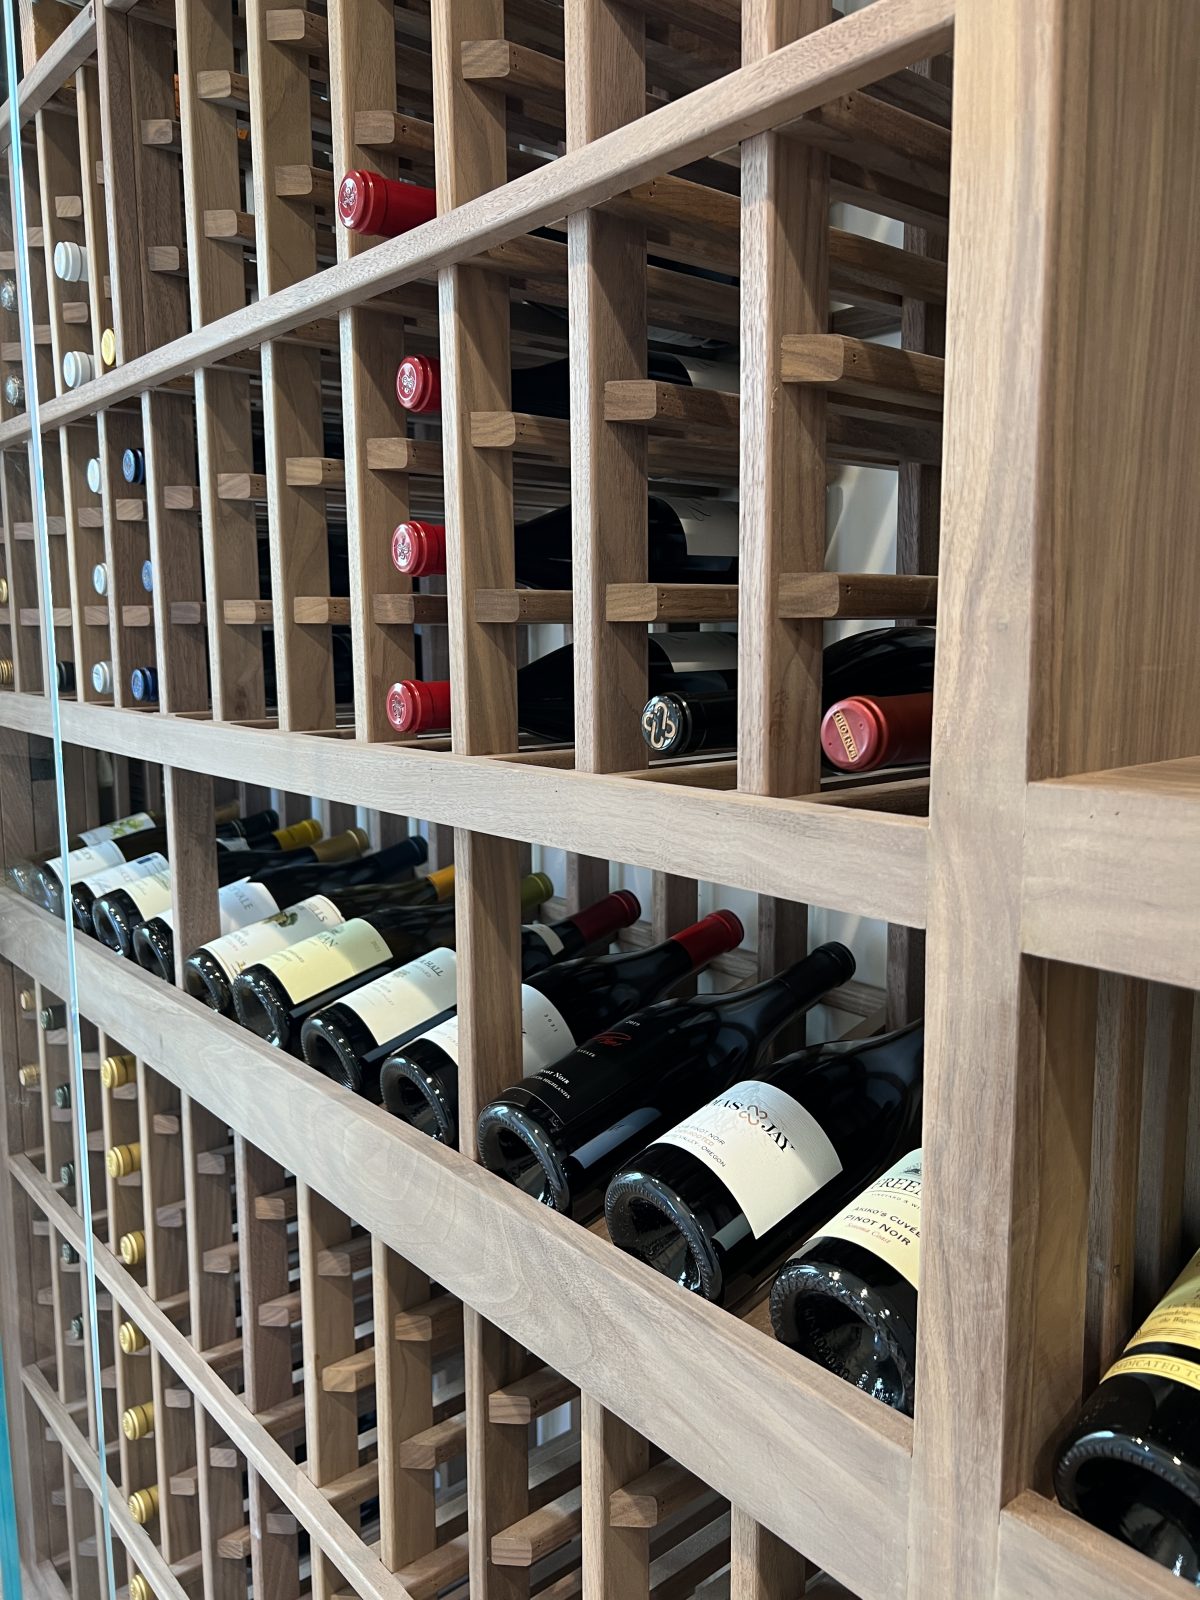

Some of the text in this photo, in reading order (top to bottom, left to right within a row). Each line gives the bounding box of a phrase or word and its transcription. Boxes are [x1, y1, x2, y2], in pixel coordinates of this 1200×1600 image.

[709, 1132, 726, 1146] NOIR
[761, 1122, 796, 1153] JAY
[700, 1144, 727, 1168] OREGON
[853, 1206, 888, 1217] AKIKO'S
[843, 1214, 911, 1246] PINOT NOIR
